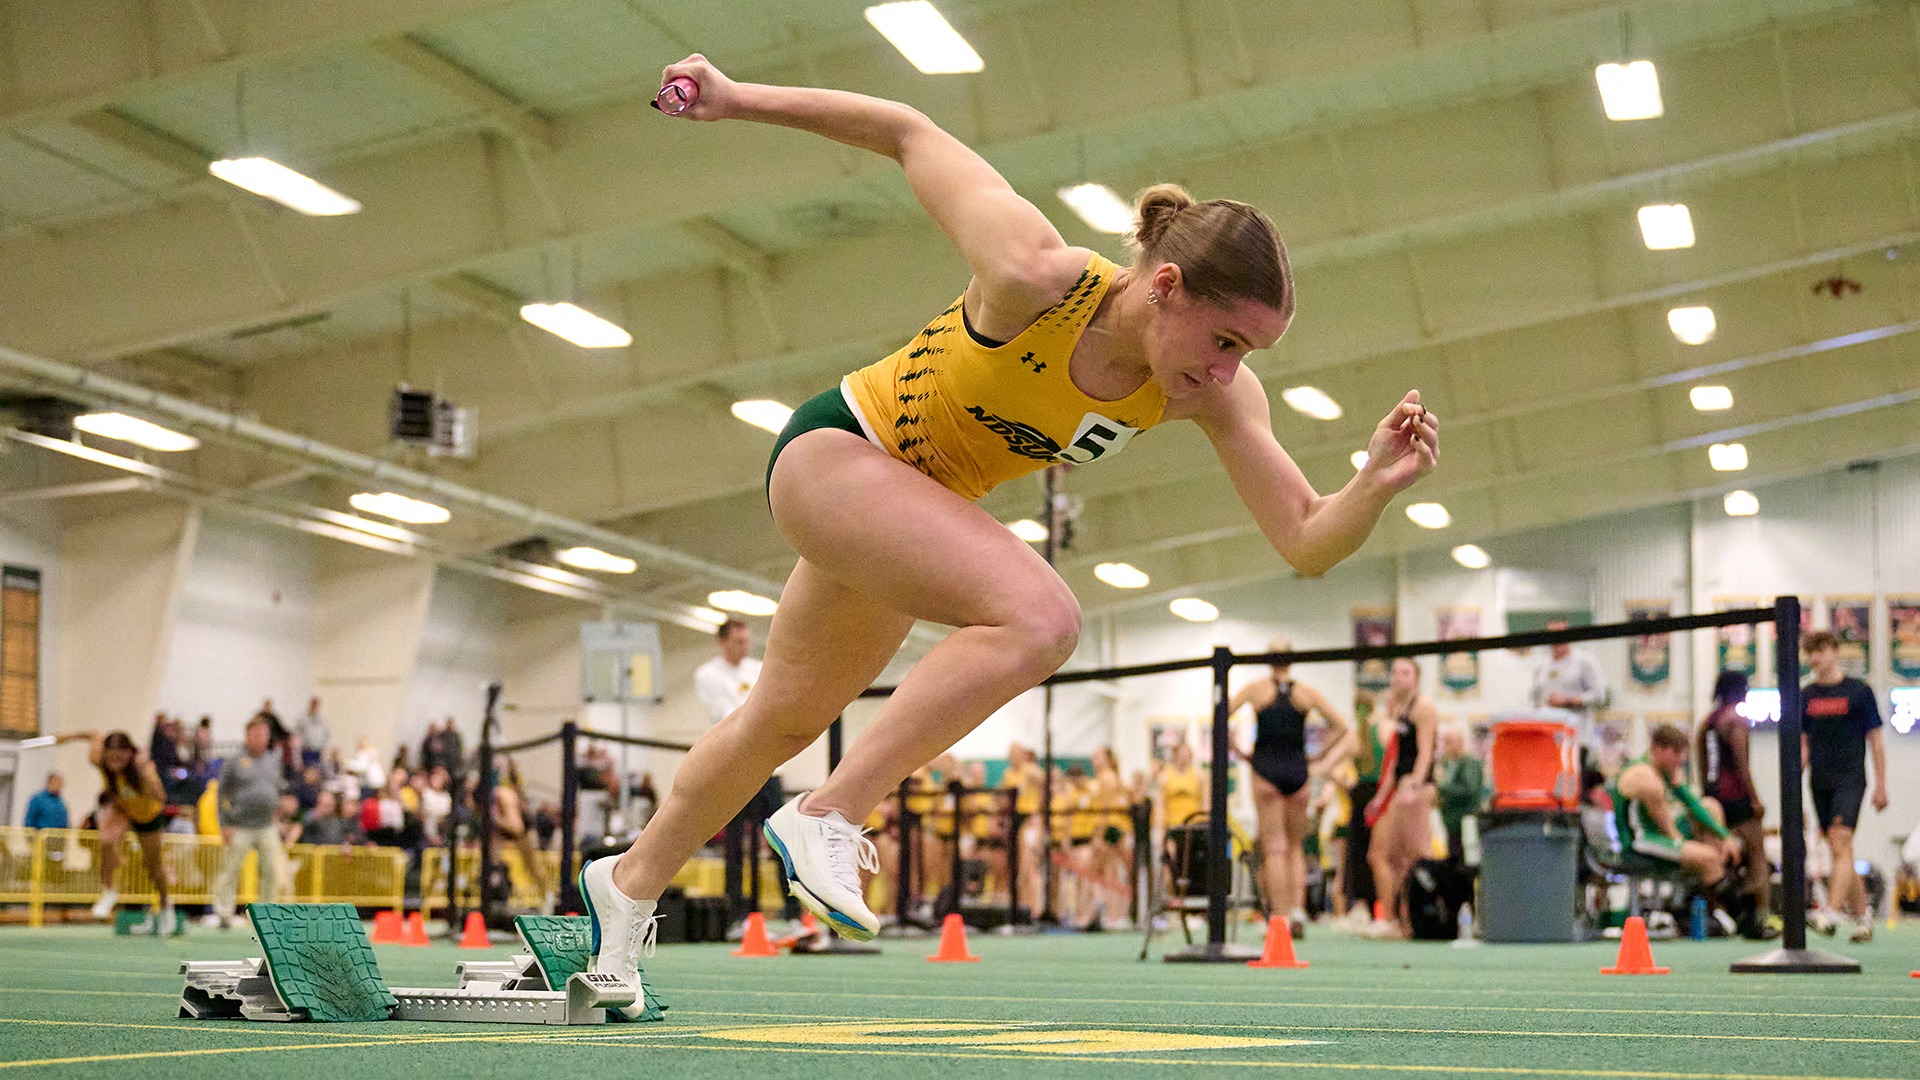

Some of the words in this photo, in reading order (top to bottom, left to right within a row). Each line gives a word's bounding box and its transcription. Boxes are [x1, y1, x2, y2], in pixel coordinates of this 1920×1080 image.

[964, 405, 1054, 456] NDSU
[1060, 423, 1118, 463] 5
[284, 921, 348, 943] GILL
[585, 974, 621, 982] GILL
